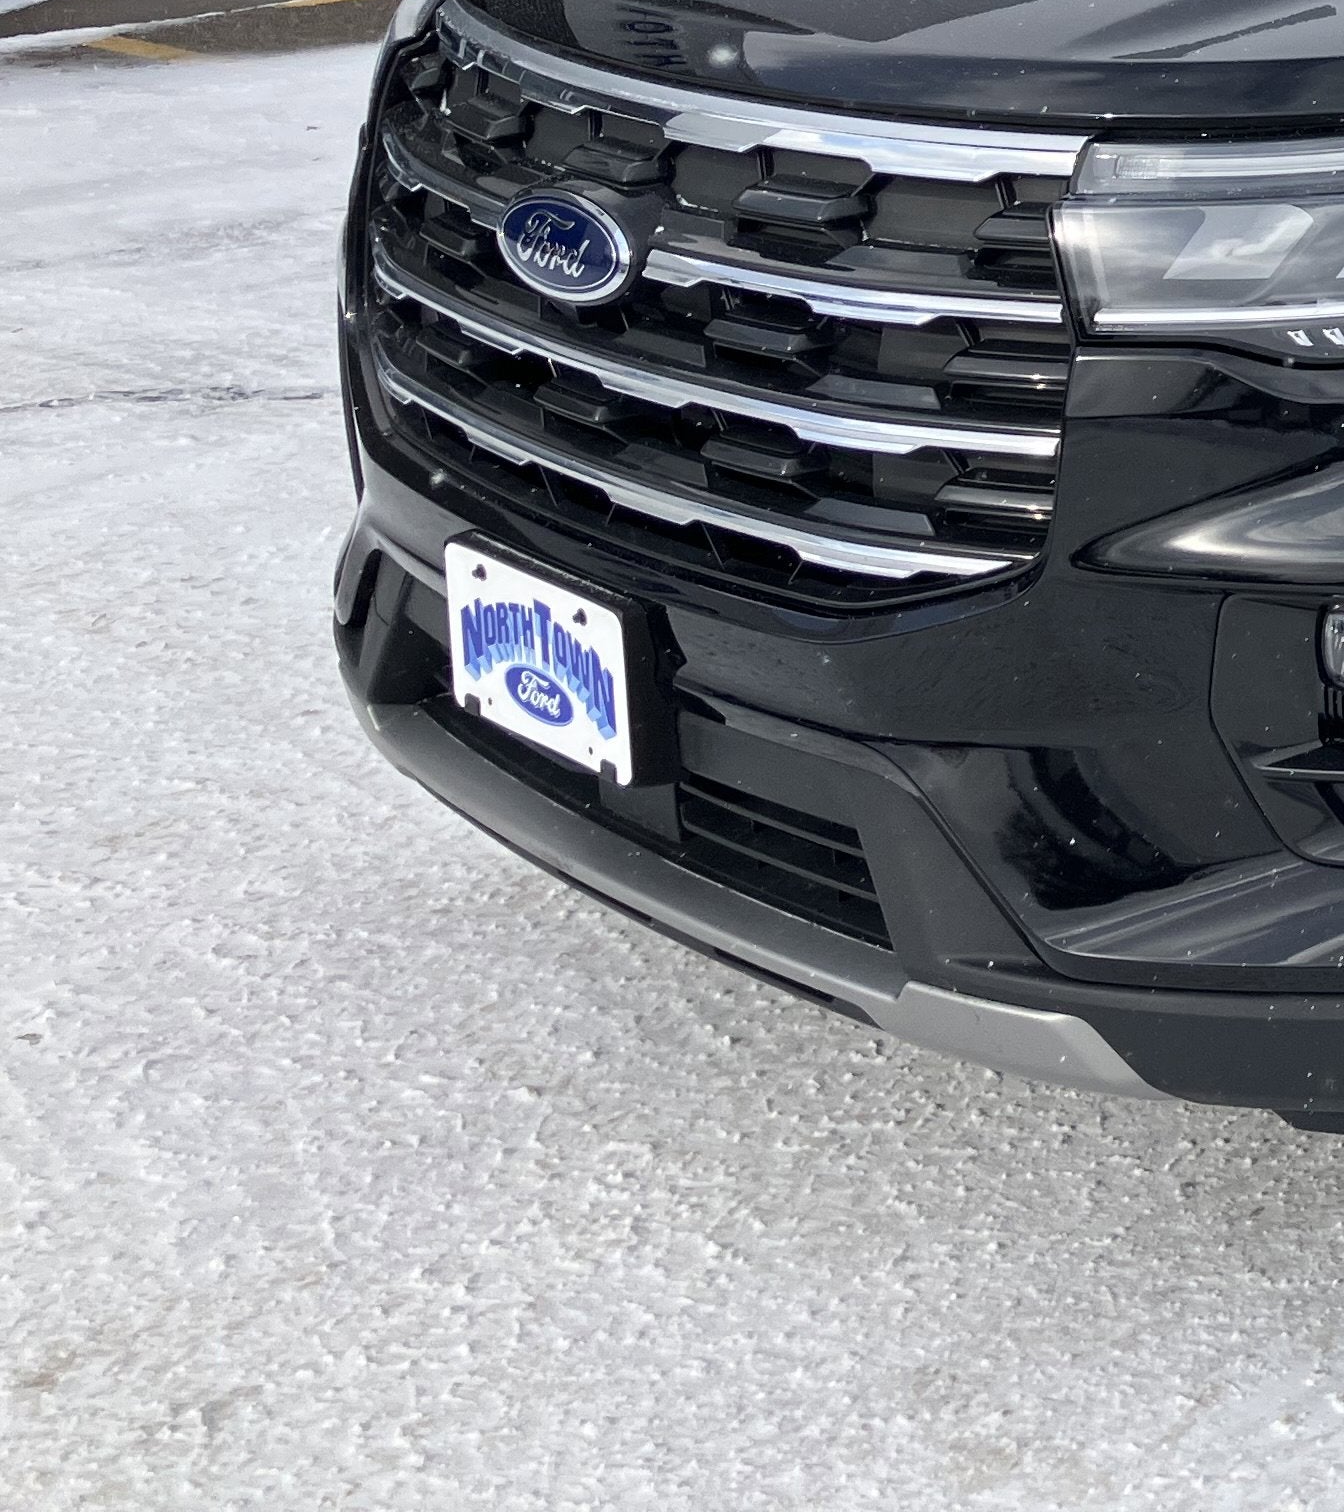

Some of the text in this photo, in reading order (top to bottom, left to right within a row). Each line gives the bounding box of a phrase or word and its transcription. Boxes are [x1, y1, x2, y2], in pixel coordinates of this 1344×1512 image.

[516, 209, 591, 278] Ford
[460, 597, 617, 740] NORTH TOWN
[517, 670, 562, 720] Ford
